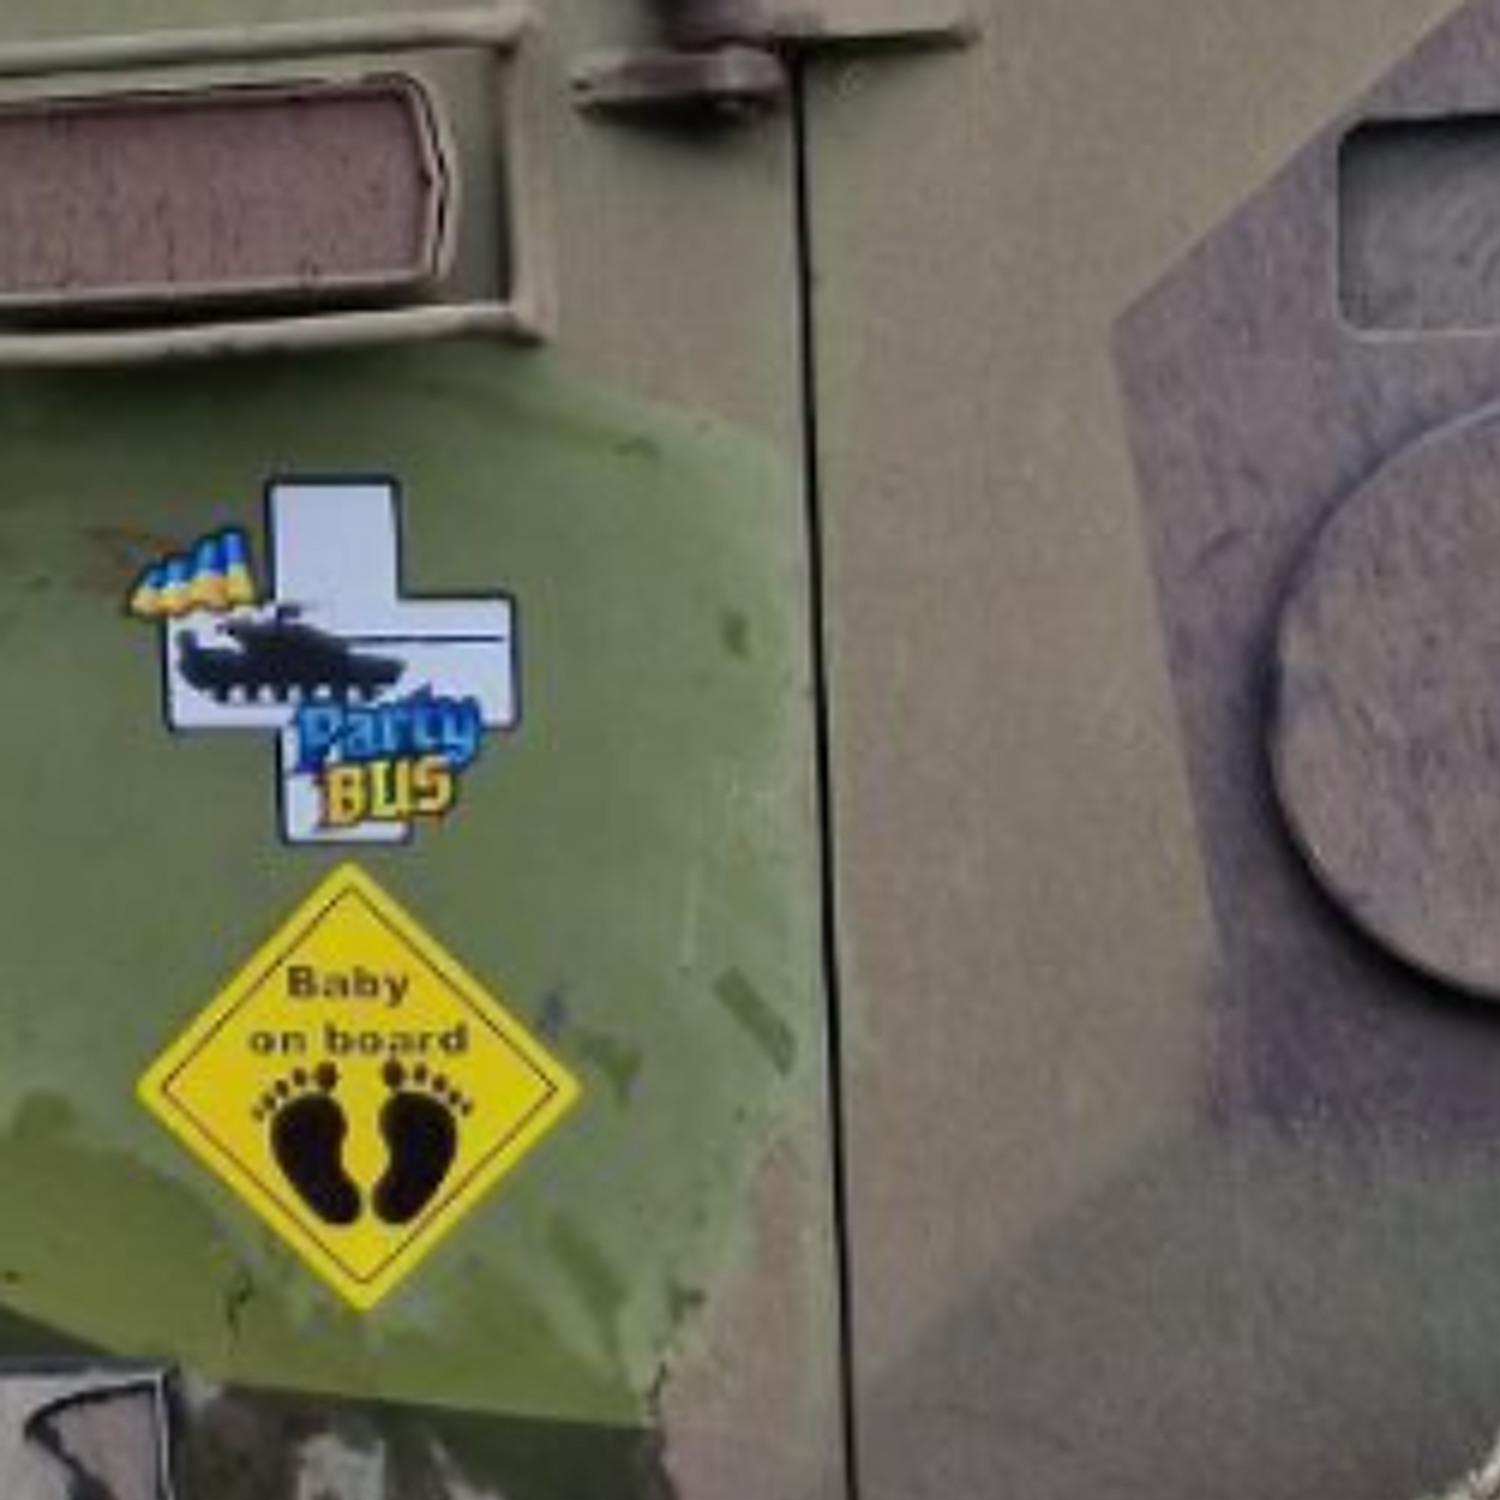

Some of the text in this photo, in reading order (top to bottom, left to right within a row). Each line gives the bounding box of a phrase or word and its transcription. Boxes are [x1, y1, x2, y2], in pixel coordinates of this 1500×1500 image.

[296, 690, 481, 772] Party
[320, 756, 455, 826] BUS
[286, 965, 410, 1006] Baby
[249, 1022, 470, 1056] on board
